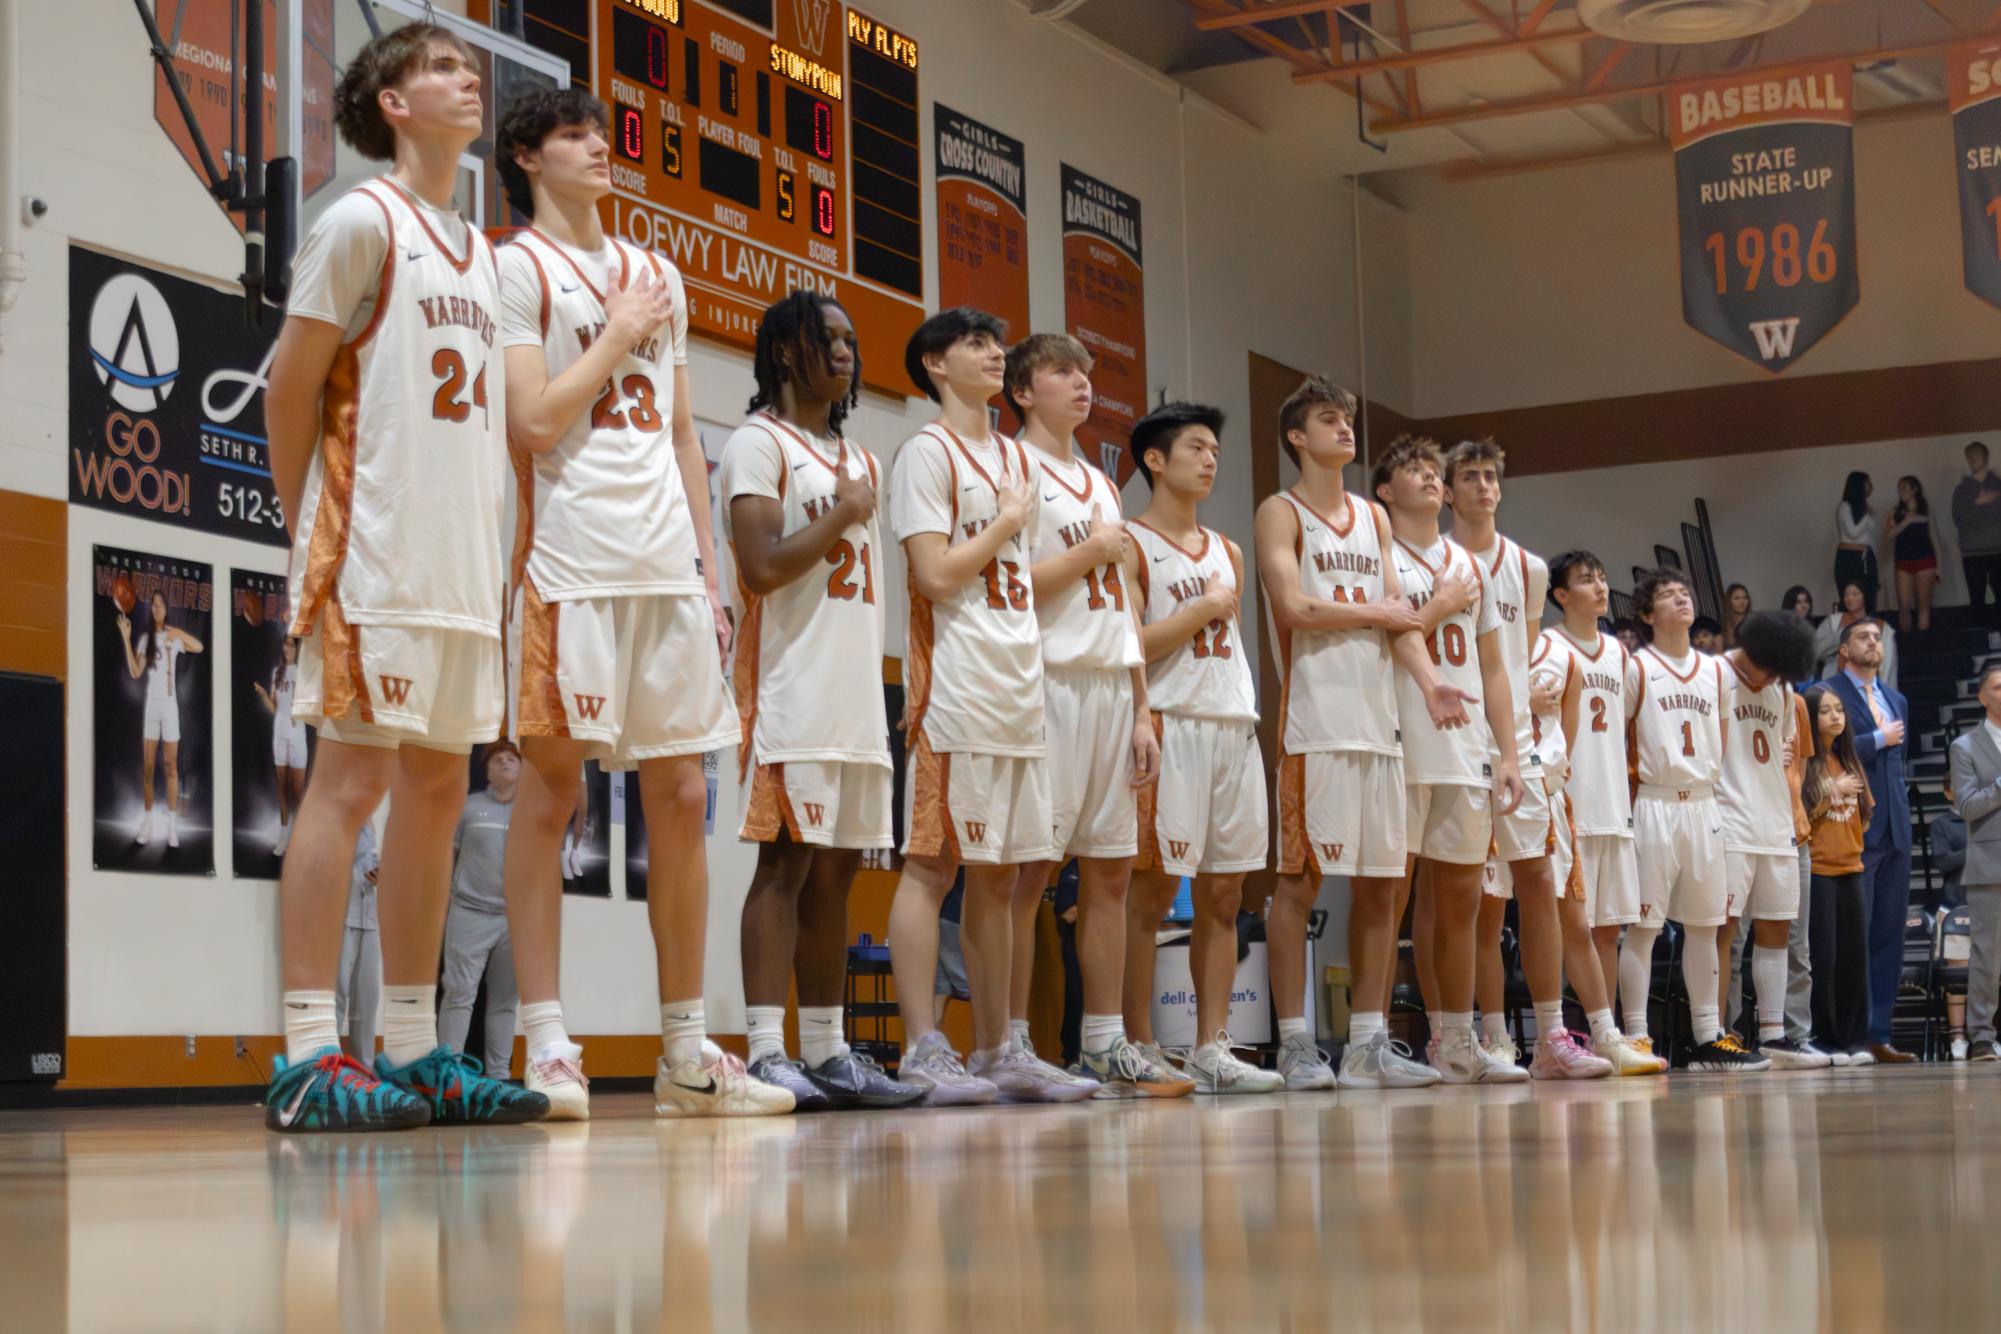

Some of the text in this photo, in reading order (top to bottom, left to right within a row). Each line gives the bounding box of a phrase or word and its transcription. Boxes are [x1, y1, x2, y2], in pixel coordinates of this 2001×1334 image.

[647, 26, 666, 88] 0
[710, 31, 745, 63] PERIOD
[848, 11, 917, 68] PLY FL PTS
[611, 78, 645, 110] FOULS
[1679, 73, 1844, 133] BASEBALL
[624, 110, 641, 158] 0
[697, 115, 735, 149] PLAYER
[814, 101, 831, 159] 0
[962, 122, 998, 150] GIRLS
[664, 126, 680, 175] 5
[940, 131, 1021, 198] CROSS COUNTRY
[1731, 147, 1796, 175] STATE
[612, 163, 647, 195] SCORE
[807, 161, 836, 190] FOULS
[1700, 167, 1833, 204] RUNNER-UP
[778, 173, 793, 218] 5
[819, 190, 833, 235] 0
[713, 203, 748, 233] MATCH
[1066, 189, 1138, 252] BASKETBALL
[614, 199, 713, 272] LOEWY
[720, 239, 777, 294] LAW
[808, 239, 838, 267] SCORE
[1705, 217, 1837, 295] 1986
[1749, 317, 1800, 360] W
[591, 374, 663, 433] 23
[105, 411, 161, 463] GO
[200, 436, 264, 466] SETH R.
[74, 448, 191, 517] WOOD!
[825, 538, 876, 606] 21
[1312, 551, 1380, 578] WARRIORS
[1084, 563, 1124, 612] 14
[1192, 618, 1232, 660] 12
[379, 674, 413, 706] W
[574, 694, 606, 721] W
[1657, 694, 1712, 718] WARRIORS
[1590, 695, 1608, 733] 2
[1681, 720, 1695, 757] 1
[1753, 729, 1770, 764] 0
[803, 802, 825, 825] W
[965, 821, 986, 843] W
[1167, 840, 1190, 860] W
[1322, 843, 1345, 862] W
[1160, 992, 1186, 1005] dell
